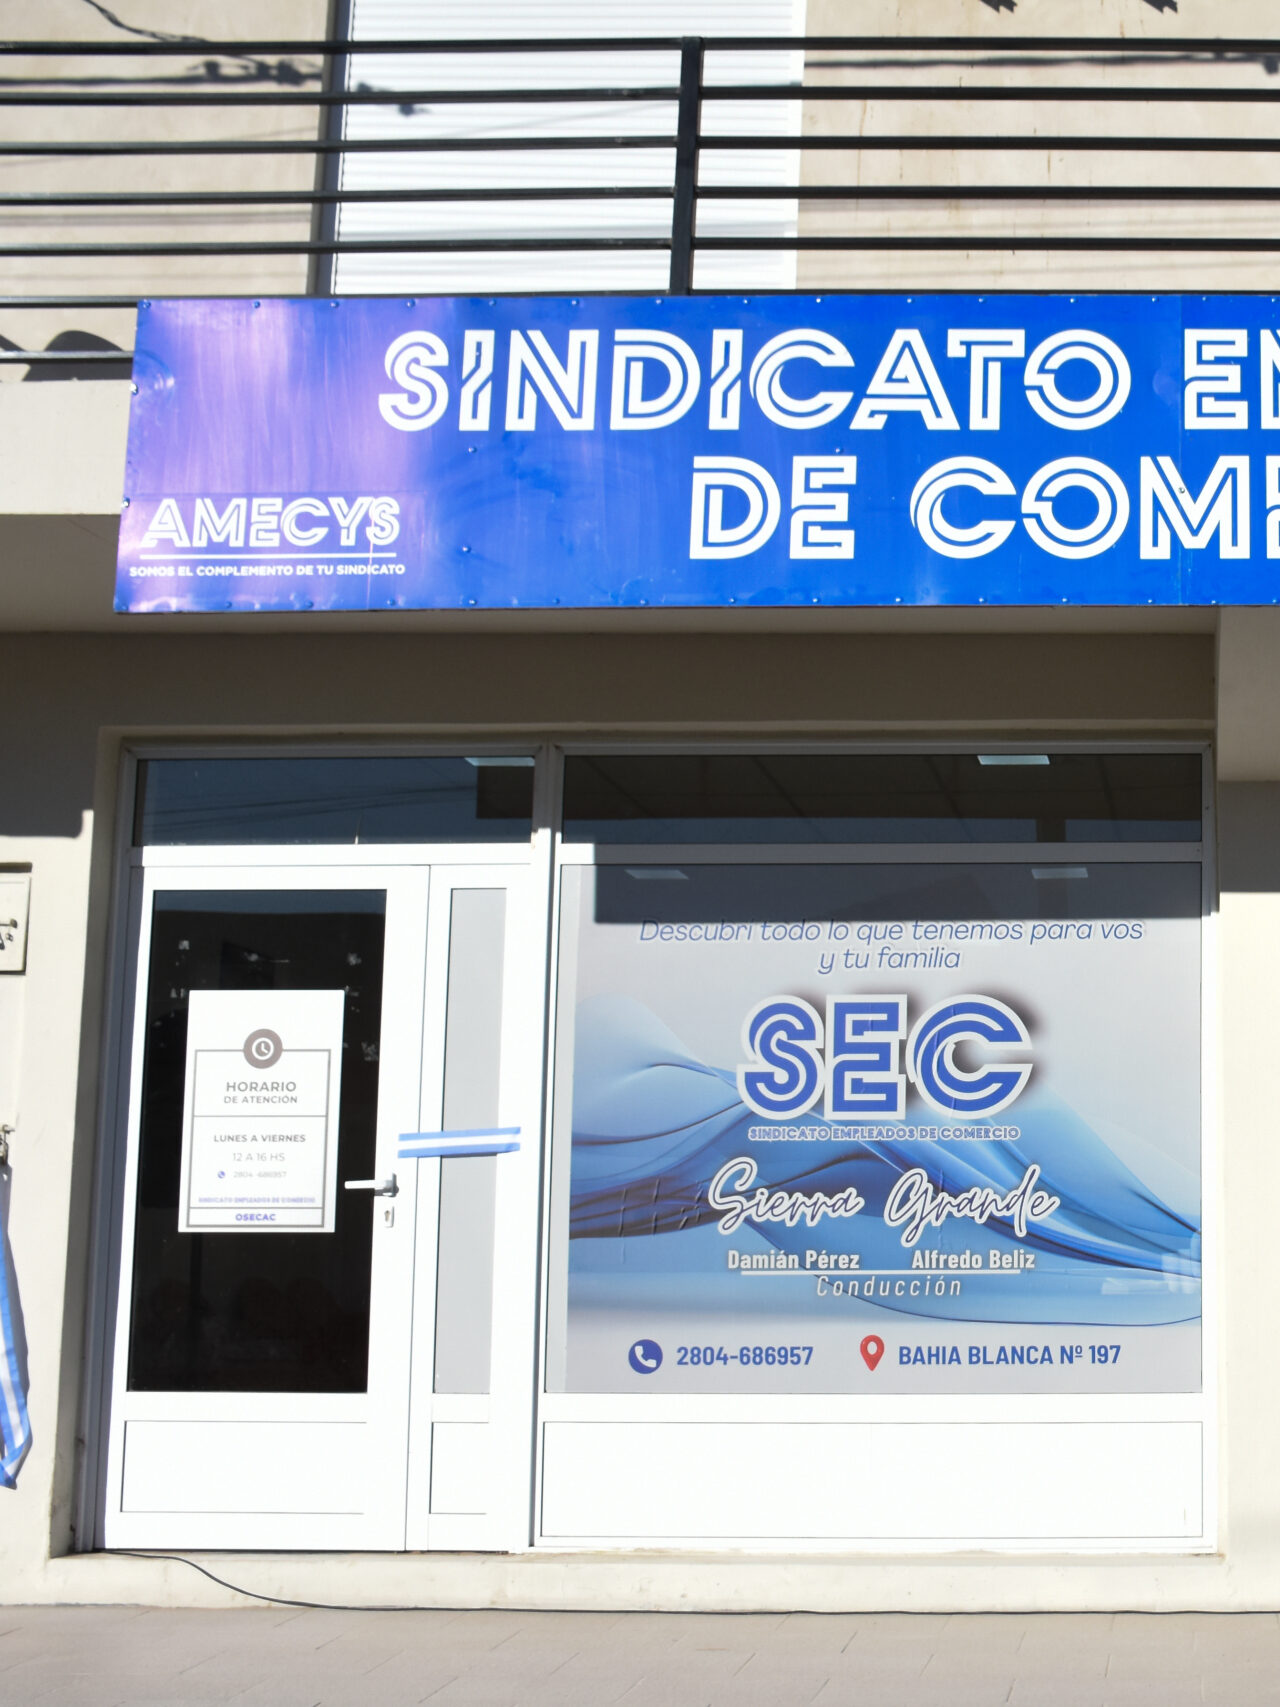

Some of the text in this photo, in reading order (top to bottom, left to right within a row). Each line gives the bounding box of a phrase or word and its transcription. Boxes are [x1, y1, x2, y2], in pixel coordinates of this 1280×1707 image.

[378, 328, 1132, 432] SINDICATO
[689, 455, 857, 559] DE
[140, 496, 400, 548] AMECYS
[129, 564, 405, 577] SOMOS EL COMPLEMENTO DE TU SINDICATO
[760, 919, 821, 941] todo
[828, 919, 849, 941] lo
[857, 923, 903, 946] que
[912, 920, 1023, 940] tenemos
[1030, 923, 1093, 945] para
[1101, 923, 1144, 940] vos
[817, 946, 961, 975] y tu familia
[736, 993, 1034, 1121] SEC
[226, 1081, 297, 1092] HORARIO
[223, 1095, 239, 1104] DE
[213, 1134, 306, 1143] LUNES A VIERNES
[748, 1126, 1022, 1141] SINDICATO EMPLEADOS DE COMERCIO
[245, 1152, 254, 1161] A
[270, 1152, 286, 1162] HS
[707, 1156, 1062, 1249] Sierra Grande
[235, 1213, 277, 1222] OSECAC
[726, 1248, 860, 1270] Damián Pérez
[911, 1249, 1036, 1270] Alfredo Beliz
[815, 1273, 963, 1298] Conducción
[676, 1345, 814, 1367] 2804-686957
[898, 1345, 964, 1366] BAHIA
[970, 1345, 1054, 1366] BLANCA
[1089, 1344, 1122, 1365] 197
